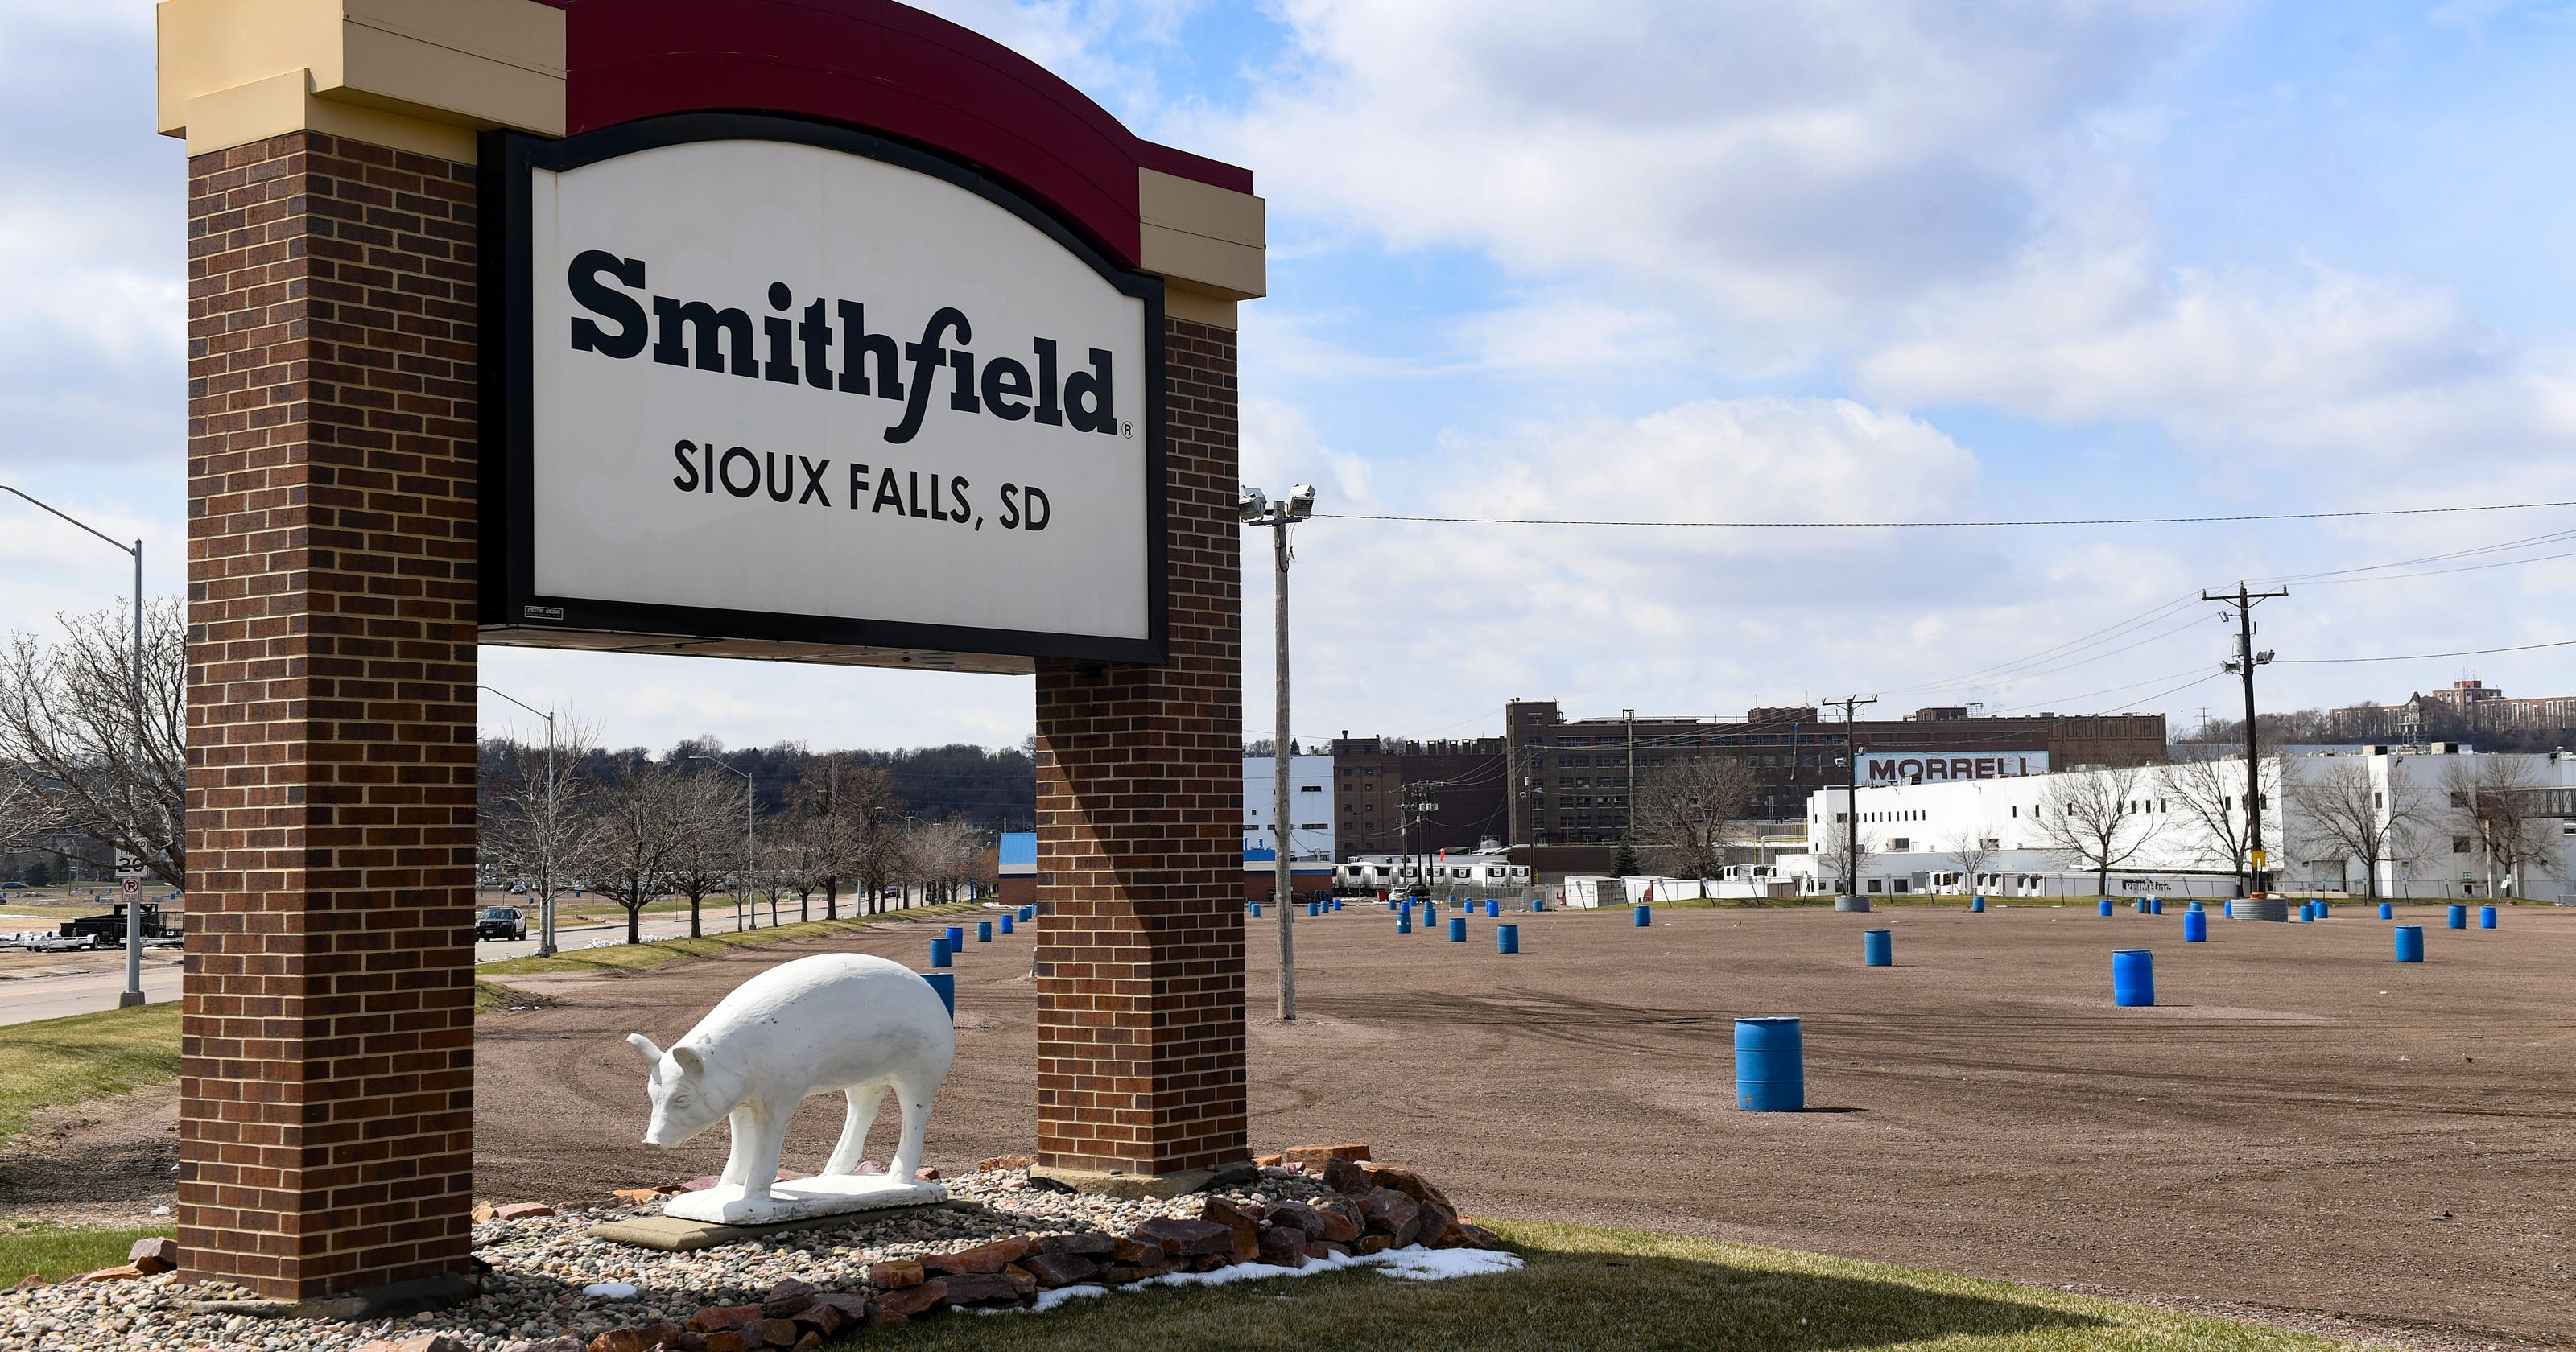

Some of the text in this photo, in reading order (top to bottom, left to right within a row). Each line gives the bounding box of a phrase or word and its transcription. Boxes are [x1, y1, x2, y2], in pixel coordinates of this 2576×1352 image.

[568, 250, 1117, 444] Smithfield
[673, 439, 1051, 532] SIOUX FALLS, SD
[119, 858, 144, 872] 20
